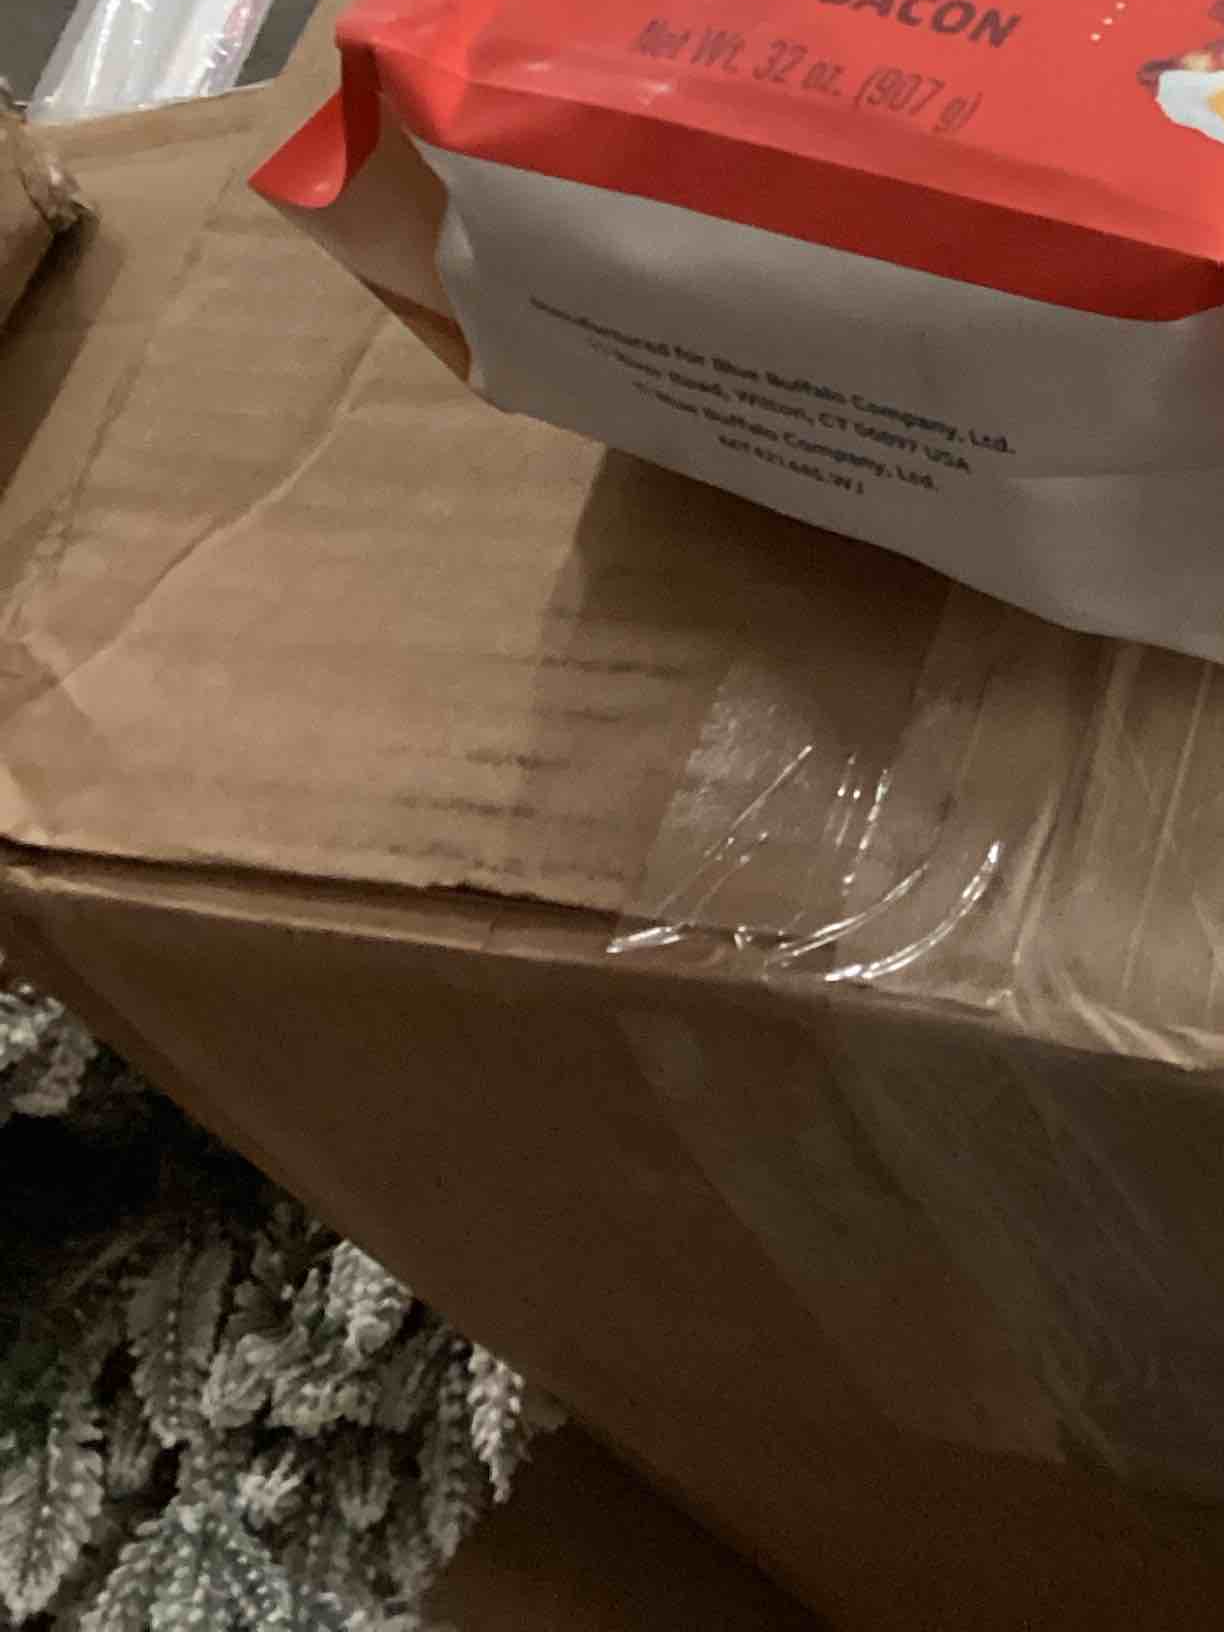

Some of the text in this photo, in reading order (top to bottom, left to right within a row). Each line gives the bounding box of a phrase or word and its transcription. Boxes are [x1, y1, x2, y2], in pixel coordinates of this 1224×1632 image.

[633, 18, 984, 134] Net Wt. 32 oz. (907 g)
[968, 428, 1017, 456] Ltd.
